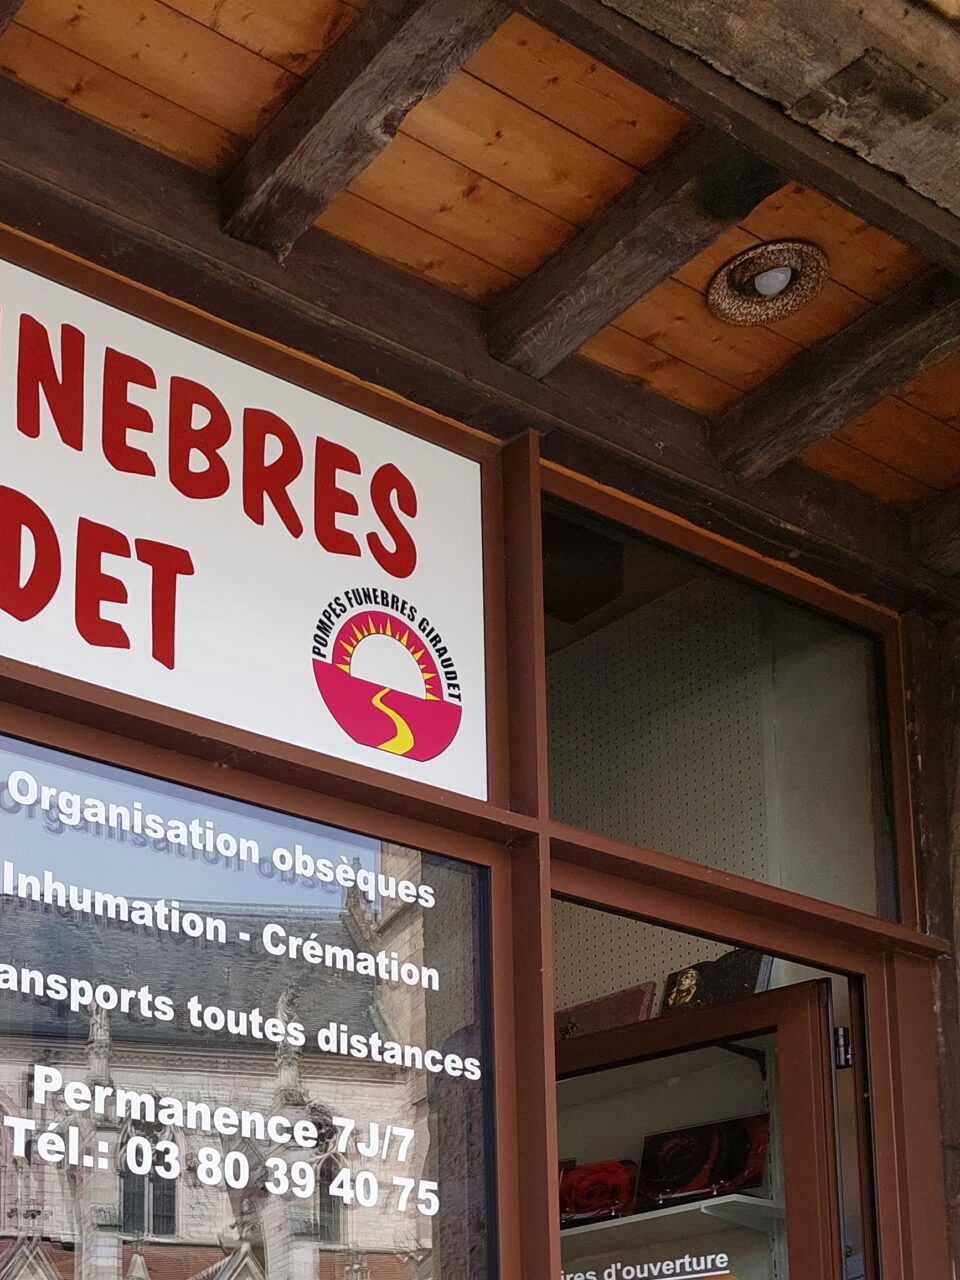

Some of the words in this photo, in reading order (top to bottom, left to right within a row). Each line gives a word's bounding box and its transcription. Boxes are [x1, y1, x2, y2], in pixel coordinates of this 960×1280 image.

[311, 595, 348, 660] POMPES
[343, 586, 418, 623] FUNEBRES
[417, 616, 462, 703] GIRAUDET
[6, 769, 259, 864] Organisation
[272, 845, 437, 908] obsèques
[2, 860, 227, 944] Inhumation
[262, 923, 440, 992] Crémation
[187, 995, 306, 1047] toutes
[317, 1022, 482, 1081] distances
[33, 1065, 319, 1148] Permanence
[3, 1116, 109, 1170] Tél.:
[126, 1136, 180, 1180] 03
[196, 1146, 249, 1189] 80
[265, 1157, 315, 1198] 39
[329, 1167, 378, 1208] 40
[392, 1176, 440, 1216] 75
